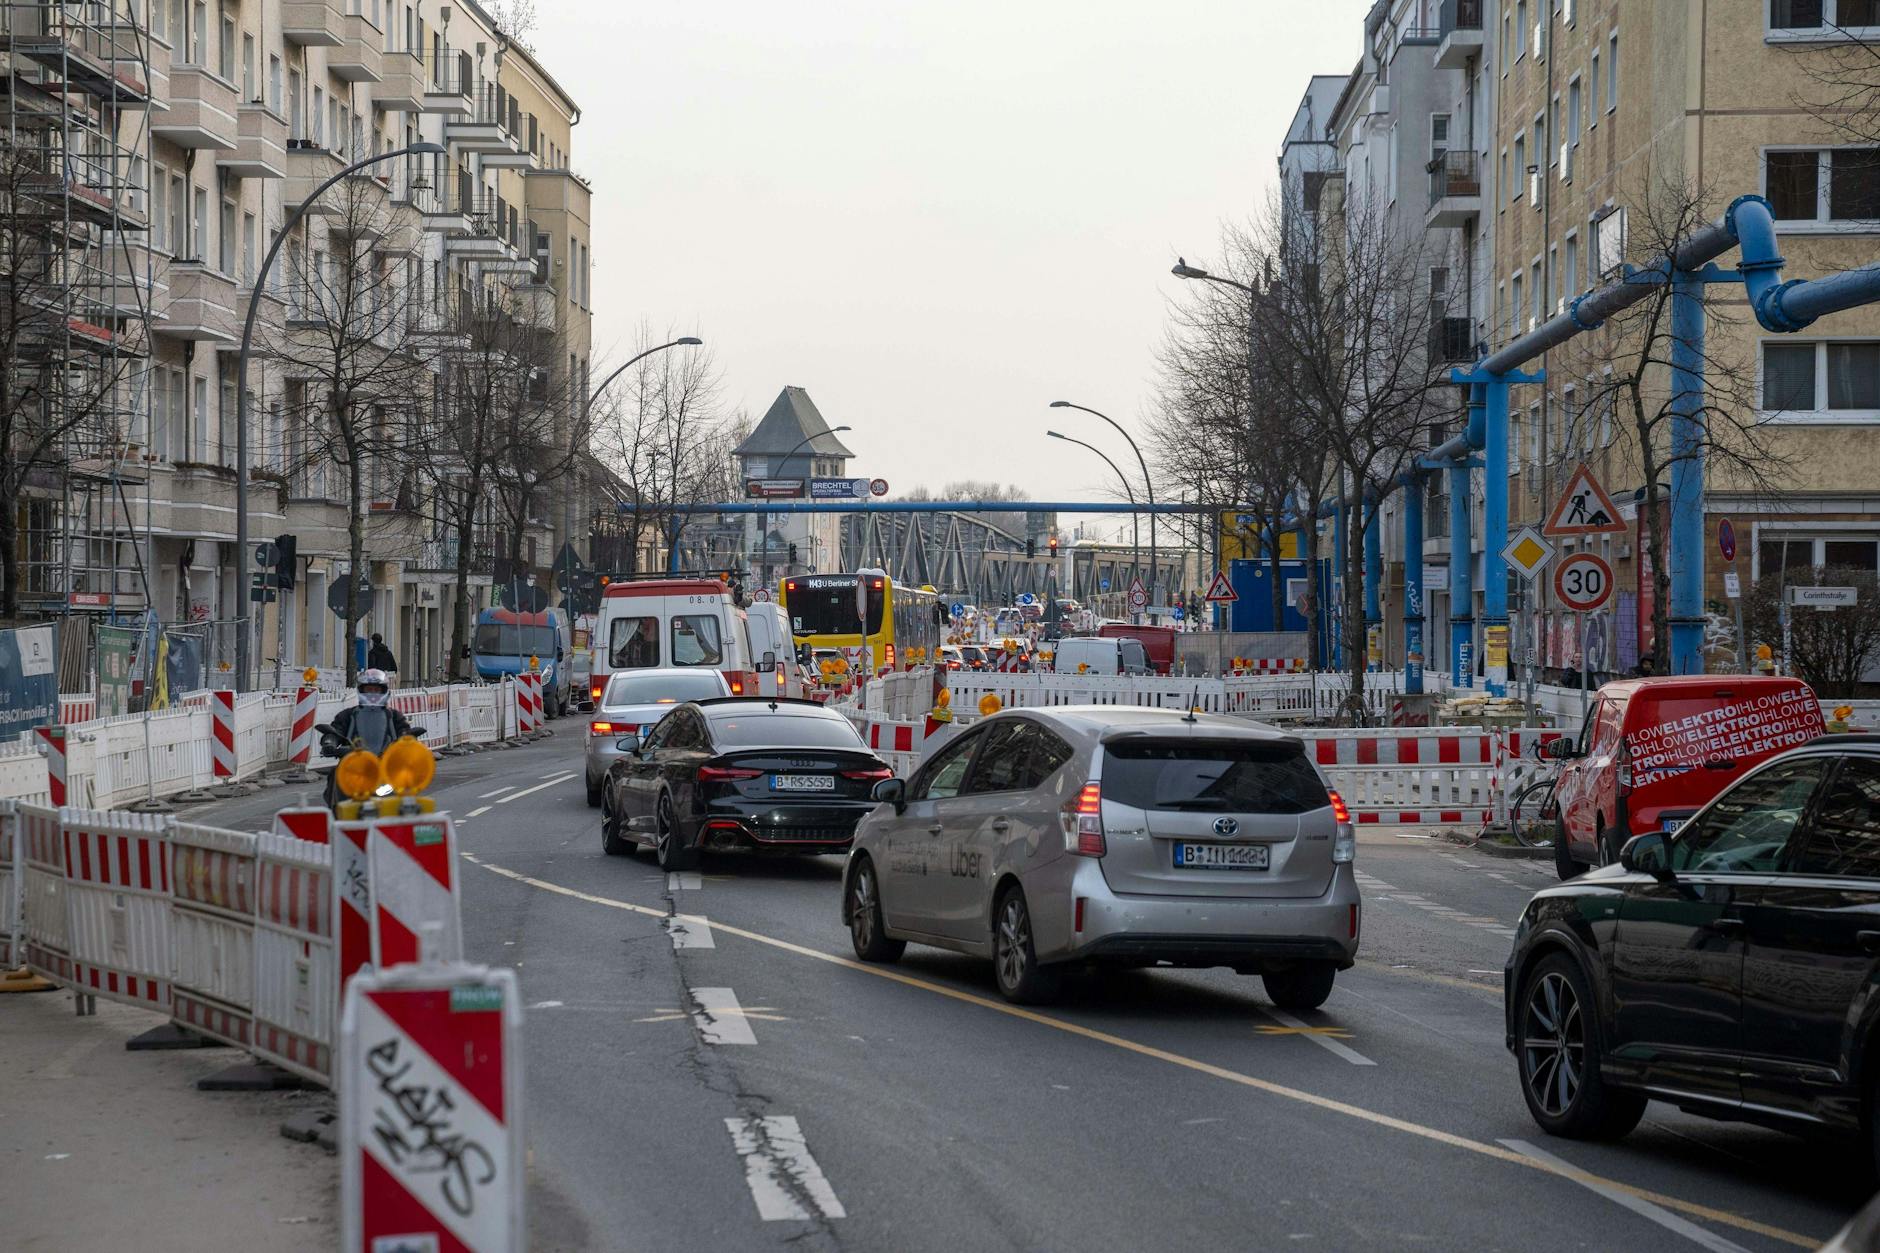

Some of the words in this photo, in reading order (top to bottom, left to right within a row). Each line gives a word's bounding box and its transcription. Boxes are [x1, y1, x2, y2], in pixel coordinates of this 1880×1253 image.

[809, 579, 822, 588] M43
[828, 579, 850, 587] Berliner
[1567, 569, 1601, 595] 30
[1803, 591, 1848, 601] Corinthstraße
[951, 842, 983, 878] Uber
